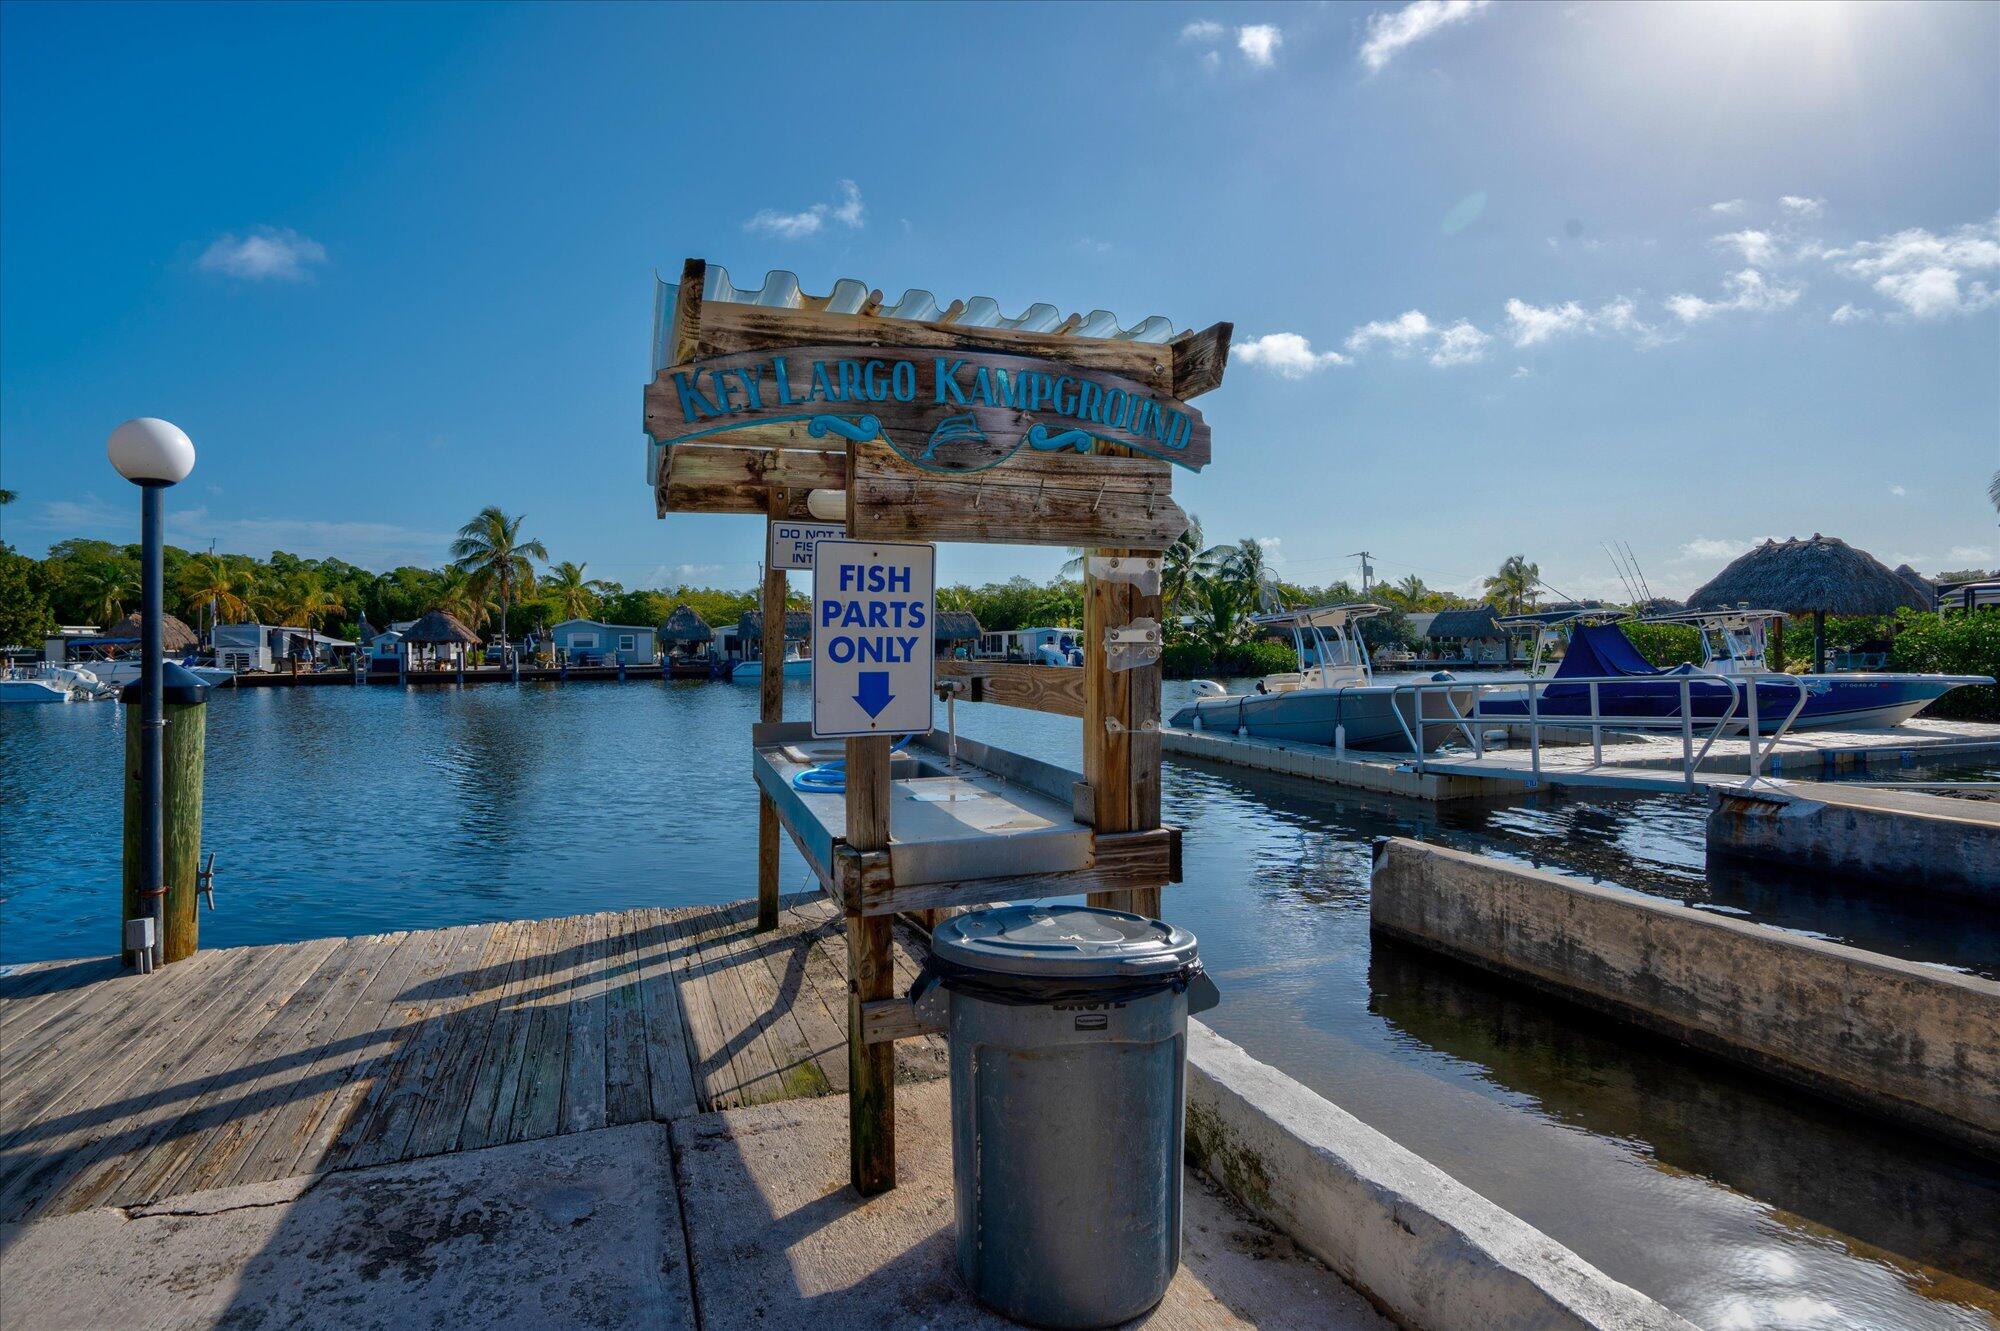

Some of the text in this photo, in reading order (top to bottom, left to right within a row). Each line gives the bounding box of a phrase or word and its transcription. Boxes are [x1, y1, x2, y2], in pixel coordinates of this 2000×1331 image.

[670, 355, 1192, 450] KEY LARGO KAMPGROUND
[780, 528, 800, 539] DO
[805, 530, 834, 539] NOT
[794, 541, 813, 552] FIS
[792, 553, 813, 563] INT
[839, 564, 911, 593] FISH
[822, 600, 926, 629] PARTS
[828, 636, 919, 663] ONLY
